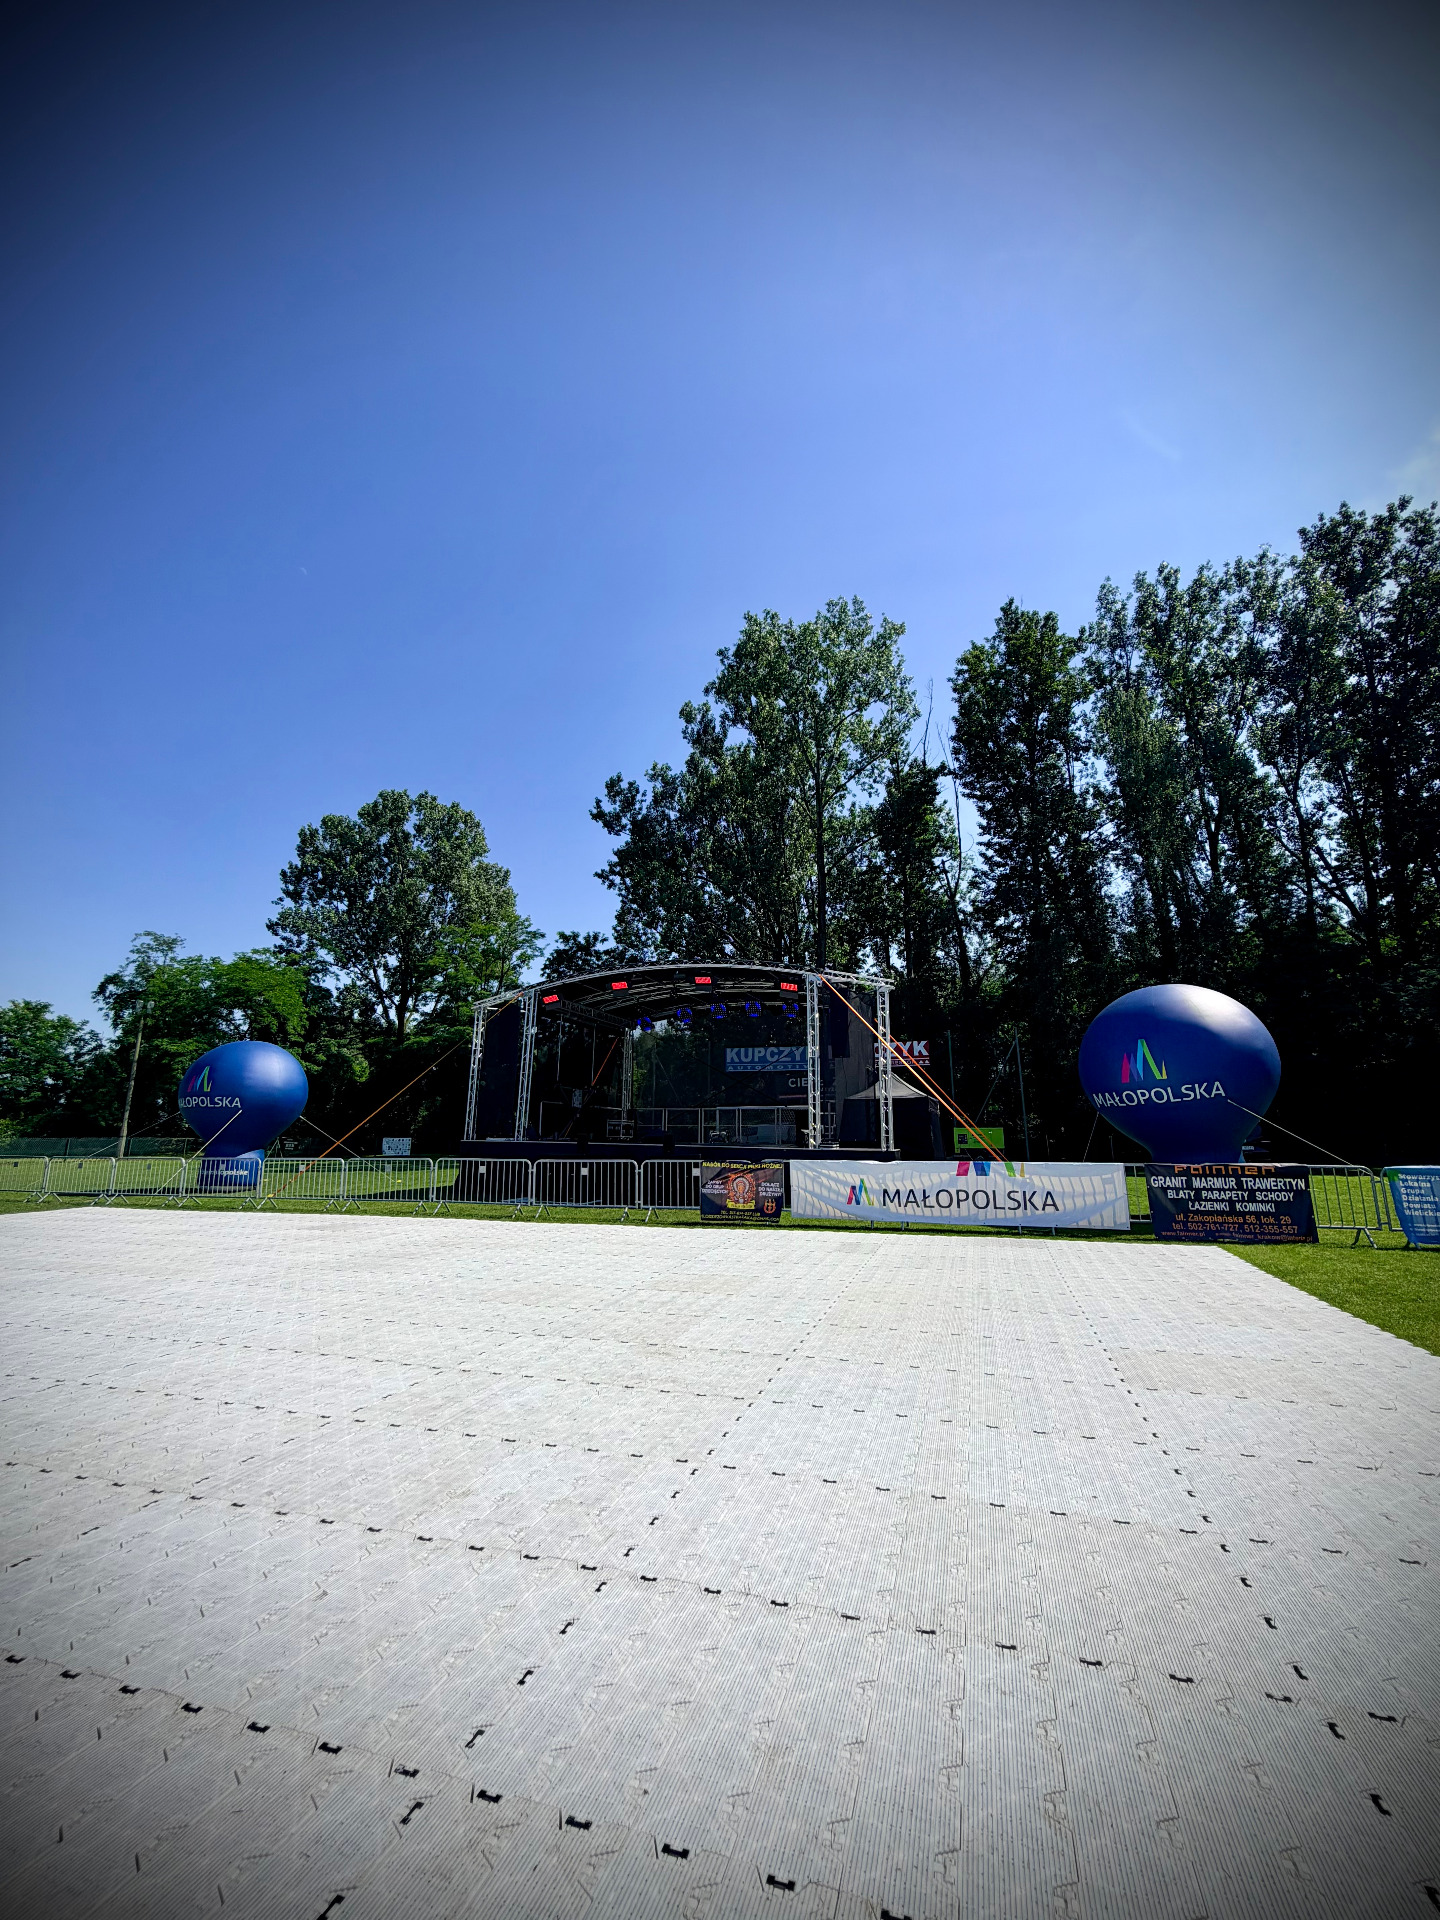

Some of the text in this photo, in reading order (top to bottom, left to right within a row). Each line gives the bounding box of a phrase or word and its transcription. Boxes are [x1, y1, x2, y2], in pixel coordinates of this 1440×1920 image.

[726, 1047, 808, 1062] KUPCZY
[1092, 1081, 1226, 1108] MAŁOPOLSKA
[1150, 1176, 1305, 1190] GRANIT MARMUR TRAWERTYN
[882, 1188, 1060, 1212] MAŁOPOLSKA
[1167, 1190, 1294, 1201] BLATY PARAPETY SCHODY
[1188, 1201, 1275, 1212] ŁAZIENKI KOMINKI
[1175, 1213, 1186, 1221] ul.
[1245, 1215, 1260, 1224] 56,
[1260, 1215, 1278, 1224] lok.
[1280, 1215, 1292, 1224] 29
[1172, 1222, 1186, 1230] tel.
[1244, 1224, 1298, 1234] 512-355-557
